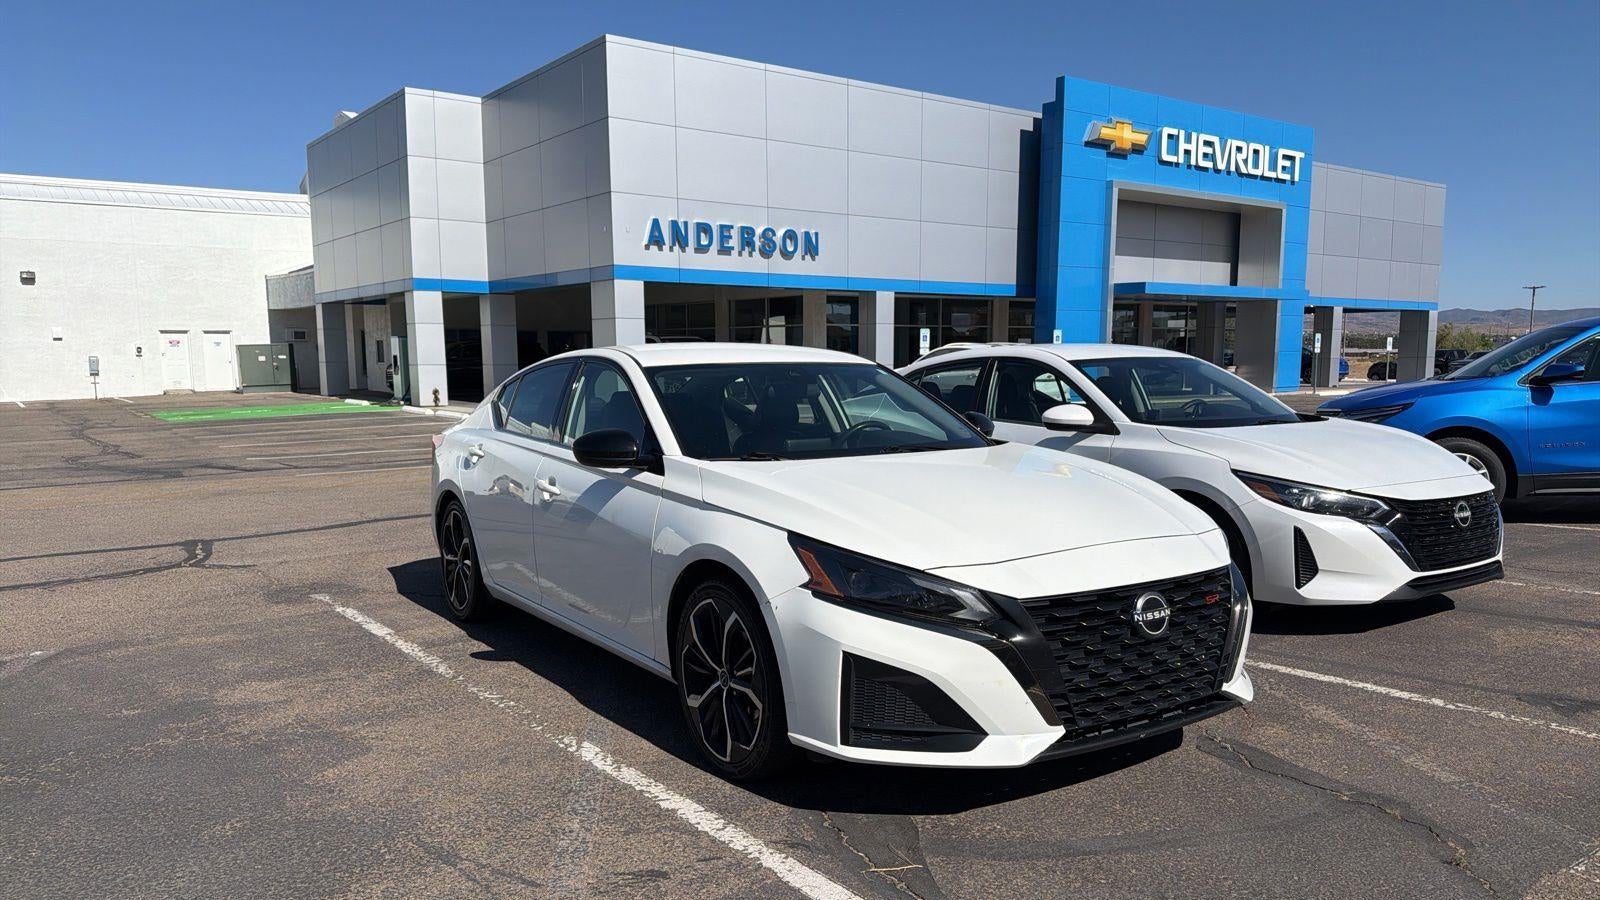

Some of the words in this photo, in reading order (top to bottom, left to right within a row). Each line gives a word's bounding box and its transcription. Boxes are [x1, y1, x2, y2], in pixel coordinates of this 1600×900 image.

[1159, 126, 1305, 182] CHEVROLET
[645, 217, 819, 258] ANDERSON
[1205, 593, 1221, 604] SR
[1134, 608, 1171, 622] NISSAN
